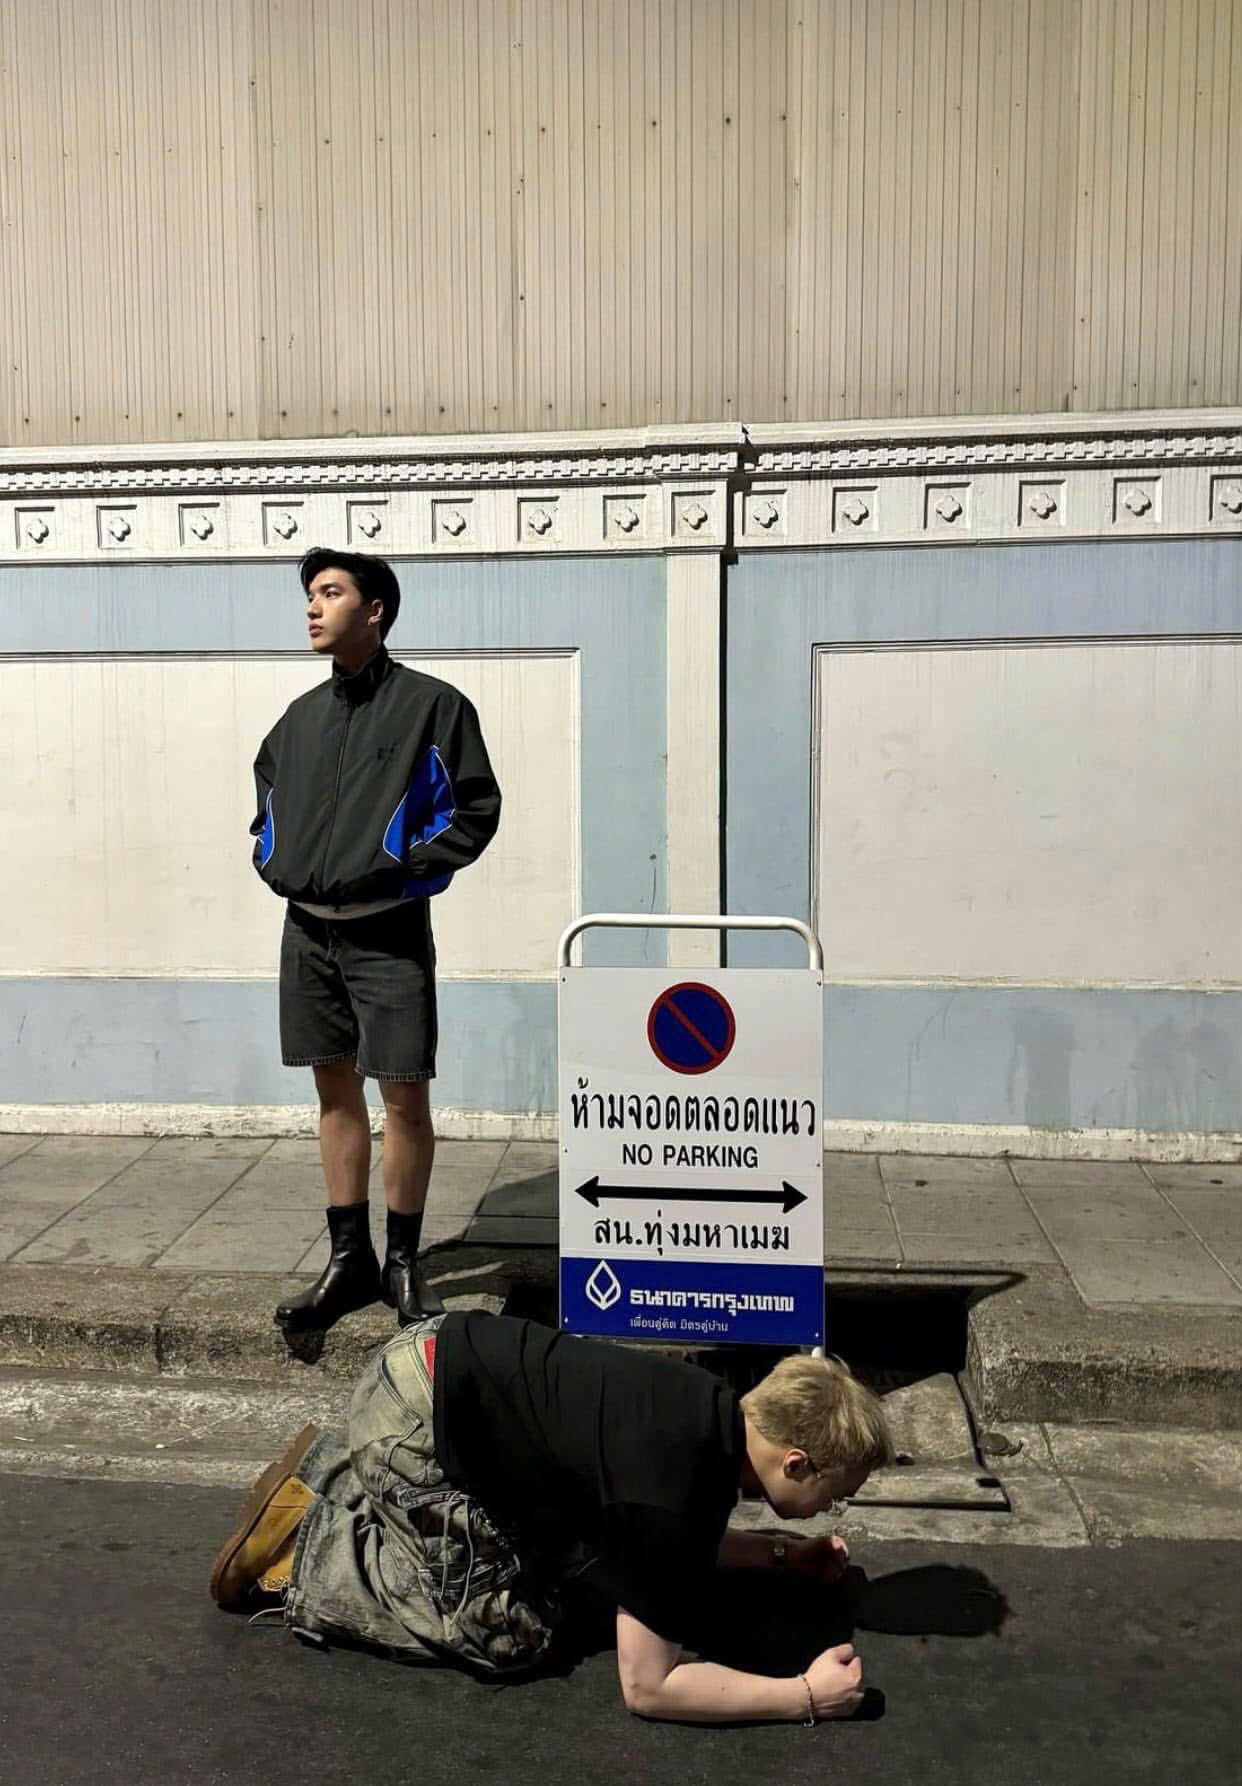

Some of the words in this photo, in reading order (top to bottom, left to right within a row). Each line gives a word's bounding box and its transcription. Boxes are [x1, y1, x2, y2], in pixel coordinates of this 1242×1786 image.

[571, 1077, 816, 1136] ห้ามจอดตลอดแนว
[622, 1143, 653, 1165] NO
[663, 1145, 759, 1169] PARKING
[594, 1209, 790, 1256] สน.ทุ่งมหาเมฆ
[629, 1289, 795, 1316] ธนาคารกรุงเทพ
